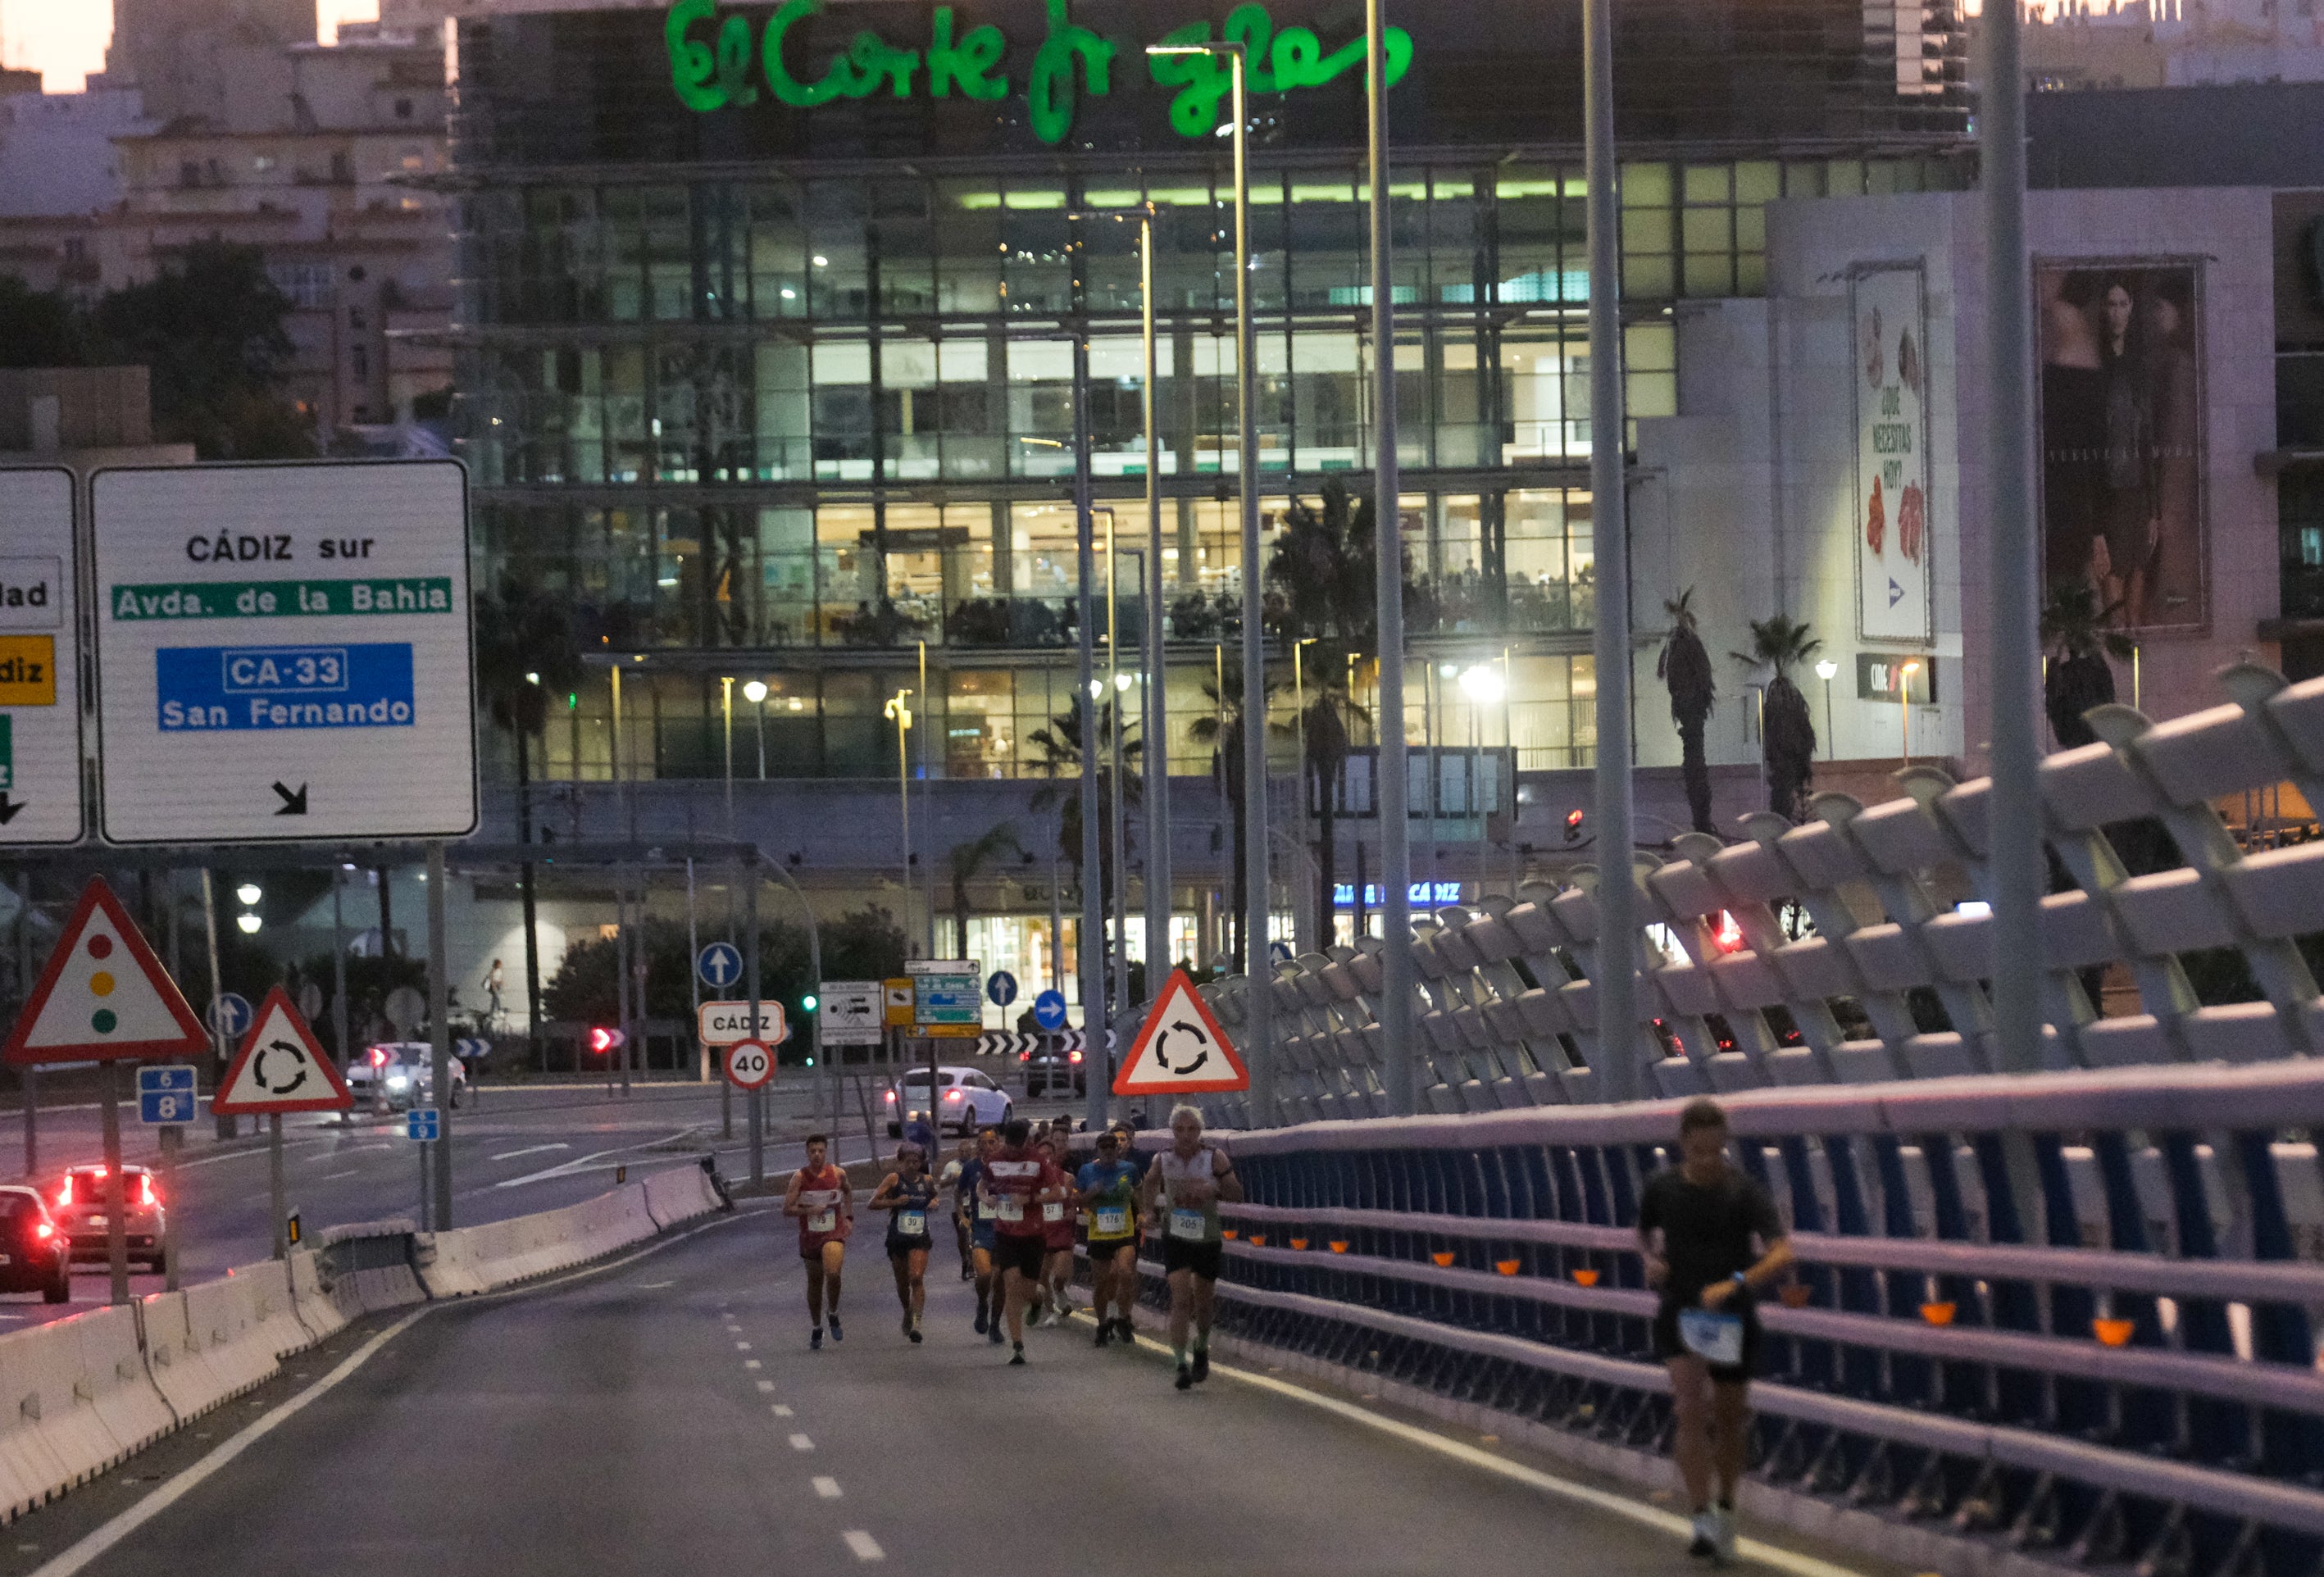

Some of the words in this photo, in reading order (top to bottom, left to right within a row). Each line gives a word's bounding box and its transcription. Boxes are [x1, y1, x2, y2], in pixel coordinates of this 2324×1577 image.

[666, 0, 757, 111] El
[762, 0, 1007, 106] Corte
[186, 529, 293, 561] CÁDIZ
[319, 537, 374, 559] sur
[116, 589, 214, 617] Avda.
[235, 588, 277, 615] de
[298, 584, 329, 611] la
[352, 581, 448, 610] Bahía
[230, 657, 340, 685] CA-33
[164, 699, 229, 727] San
[250, 698, 411, 725] Fernando
[713, 1014, 770, 1030] CÁDZ
[735, 1055, 766, 1071] 40
[160, 1070, 173, 1088] 6
[159, 1095, 177, 1120] 8
